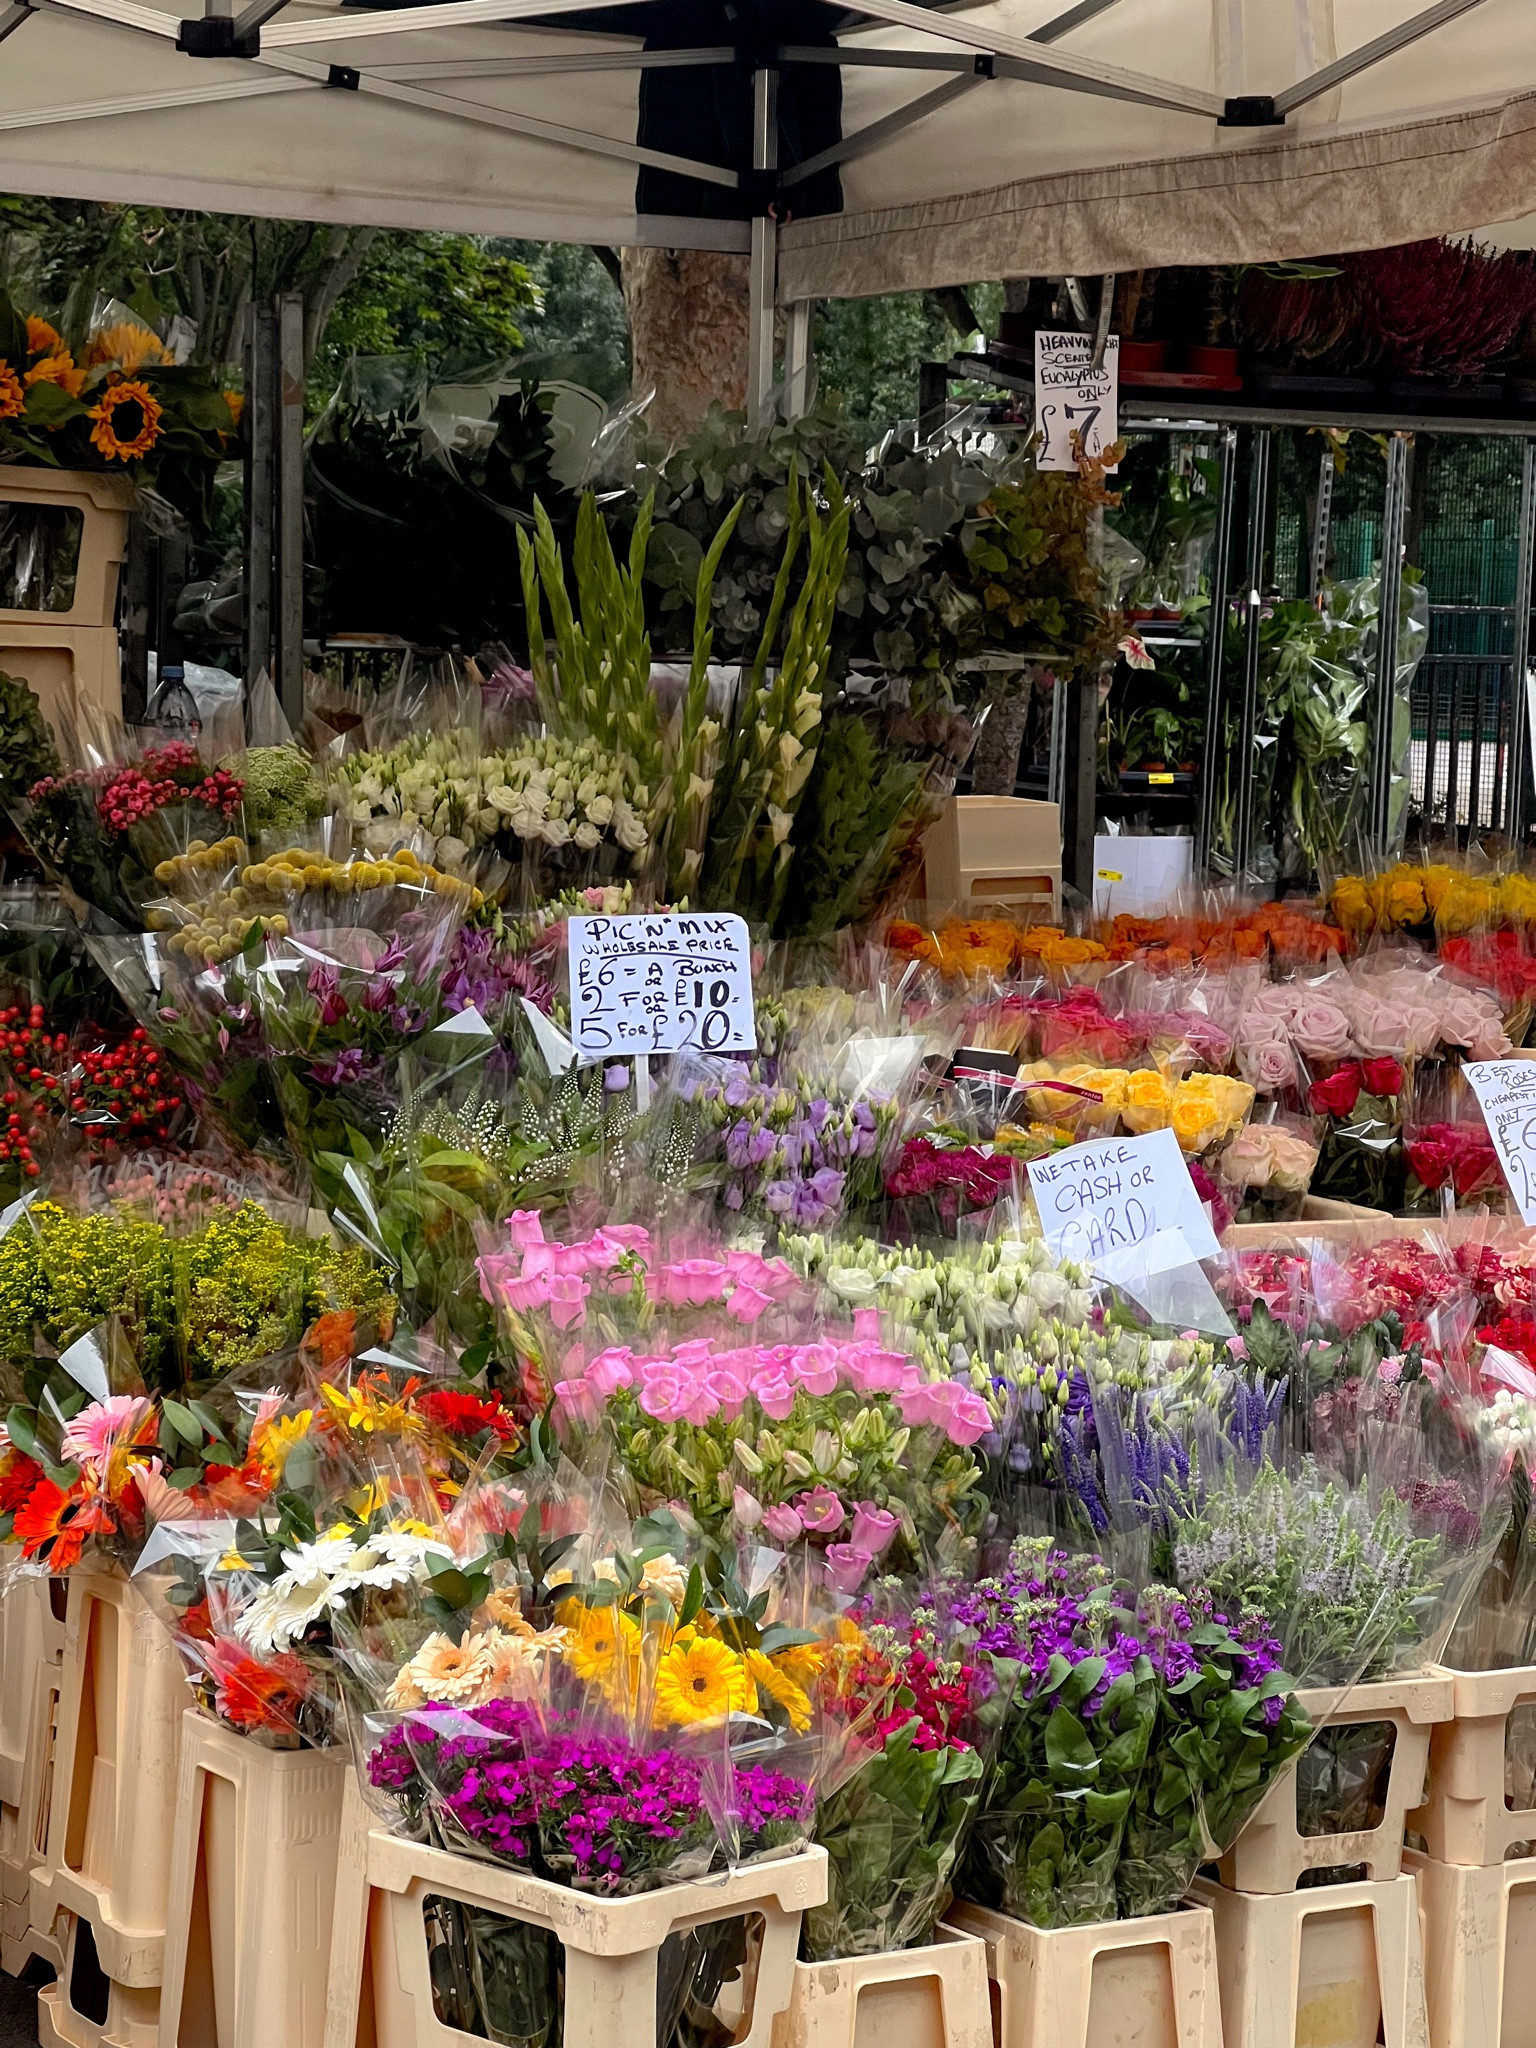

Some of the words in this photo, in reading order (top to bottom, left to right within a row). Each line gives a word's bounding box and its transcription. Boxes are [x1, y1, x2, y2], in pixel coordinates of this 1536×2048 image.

[1042, 351, 1091, 365] SCENTE
[1078, 385, 1112, 400] ONLY
[584, 918, 636, 942] PIC
[678, 919, 735, 936] MIX
[582, 941, 680, 955] WHOLESALE
[686, 937, 740, 953] PRICE
[648, 962, 664, 978] A
[672, 959, 738, 977] BUNCH
[645, 977, 663, 987] OR
[581, 985, 616, 1015] 2
[618, 991, 669, 1007] FOR
[645, 1004, 665, 1015] OR
[580, 1016, 613, 1050] 5
[617, 1021, 649, 1039] FOR
[1469, 1064, 1517, 1084] BEST
[1484, 1091, 1530, 1110] CHEAPEST
[1495, 1108, 1520, 1127] ONLY
[1032, 1164, 1062, 1184] WE
[1061, 1145, 1138, 1172] TAKE
[1054, 1171, 1124, 1213] CASH
[1130, 1165, 1155, 1188] OR
